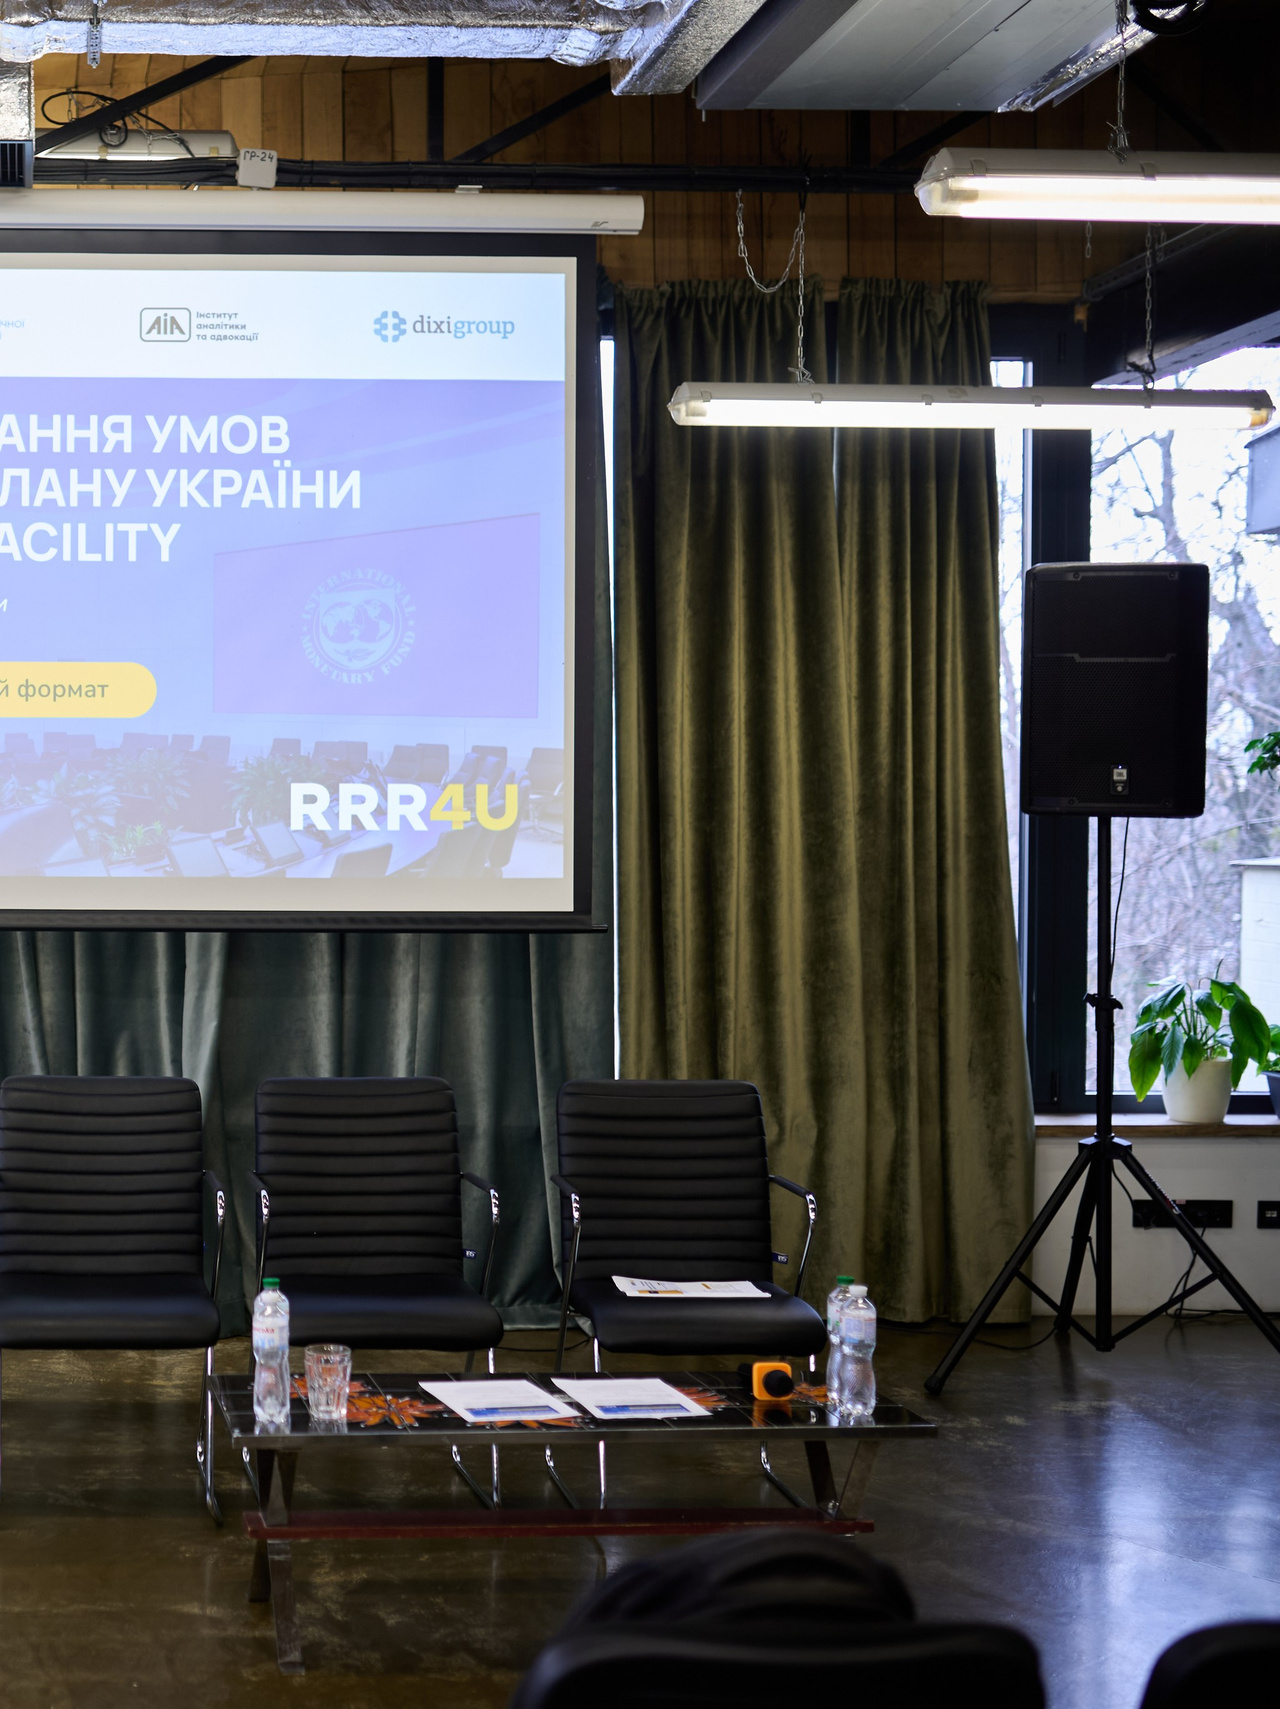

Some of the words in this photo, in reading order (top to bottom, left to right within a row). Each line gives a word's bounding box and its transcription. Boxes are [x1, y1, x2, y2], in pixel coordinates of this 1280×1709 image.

[195, 321, 247, 330] аналітики
[196, 311, 239, 321] Інститут
[413, 315, 514, 339] dixigroup
[209, 332, 259, 342] адвокації
[145, 415, 289, 454] УМОВ
[145, 460, 360, 508] УКРАЇНИ
[381, 631, 416, 675] FUND
[18, 679, 108, 702] формат
[289, 782, 519, 832] RRR4U
